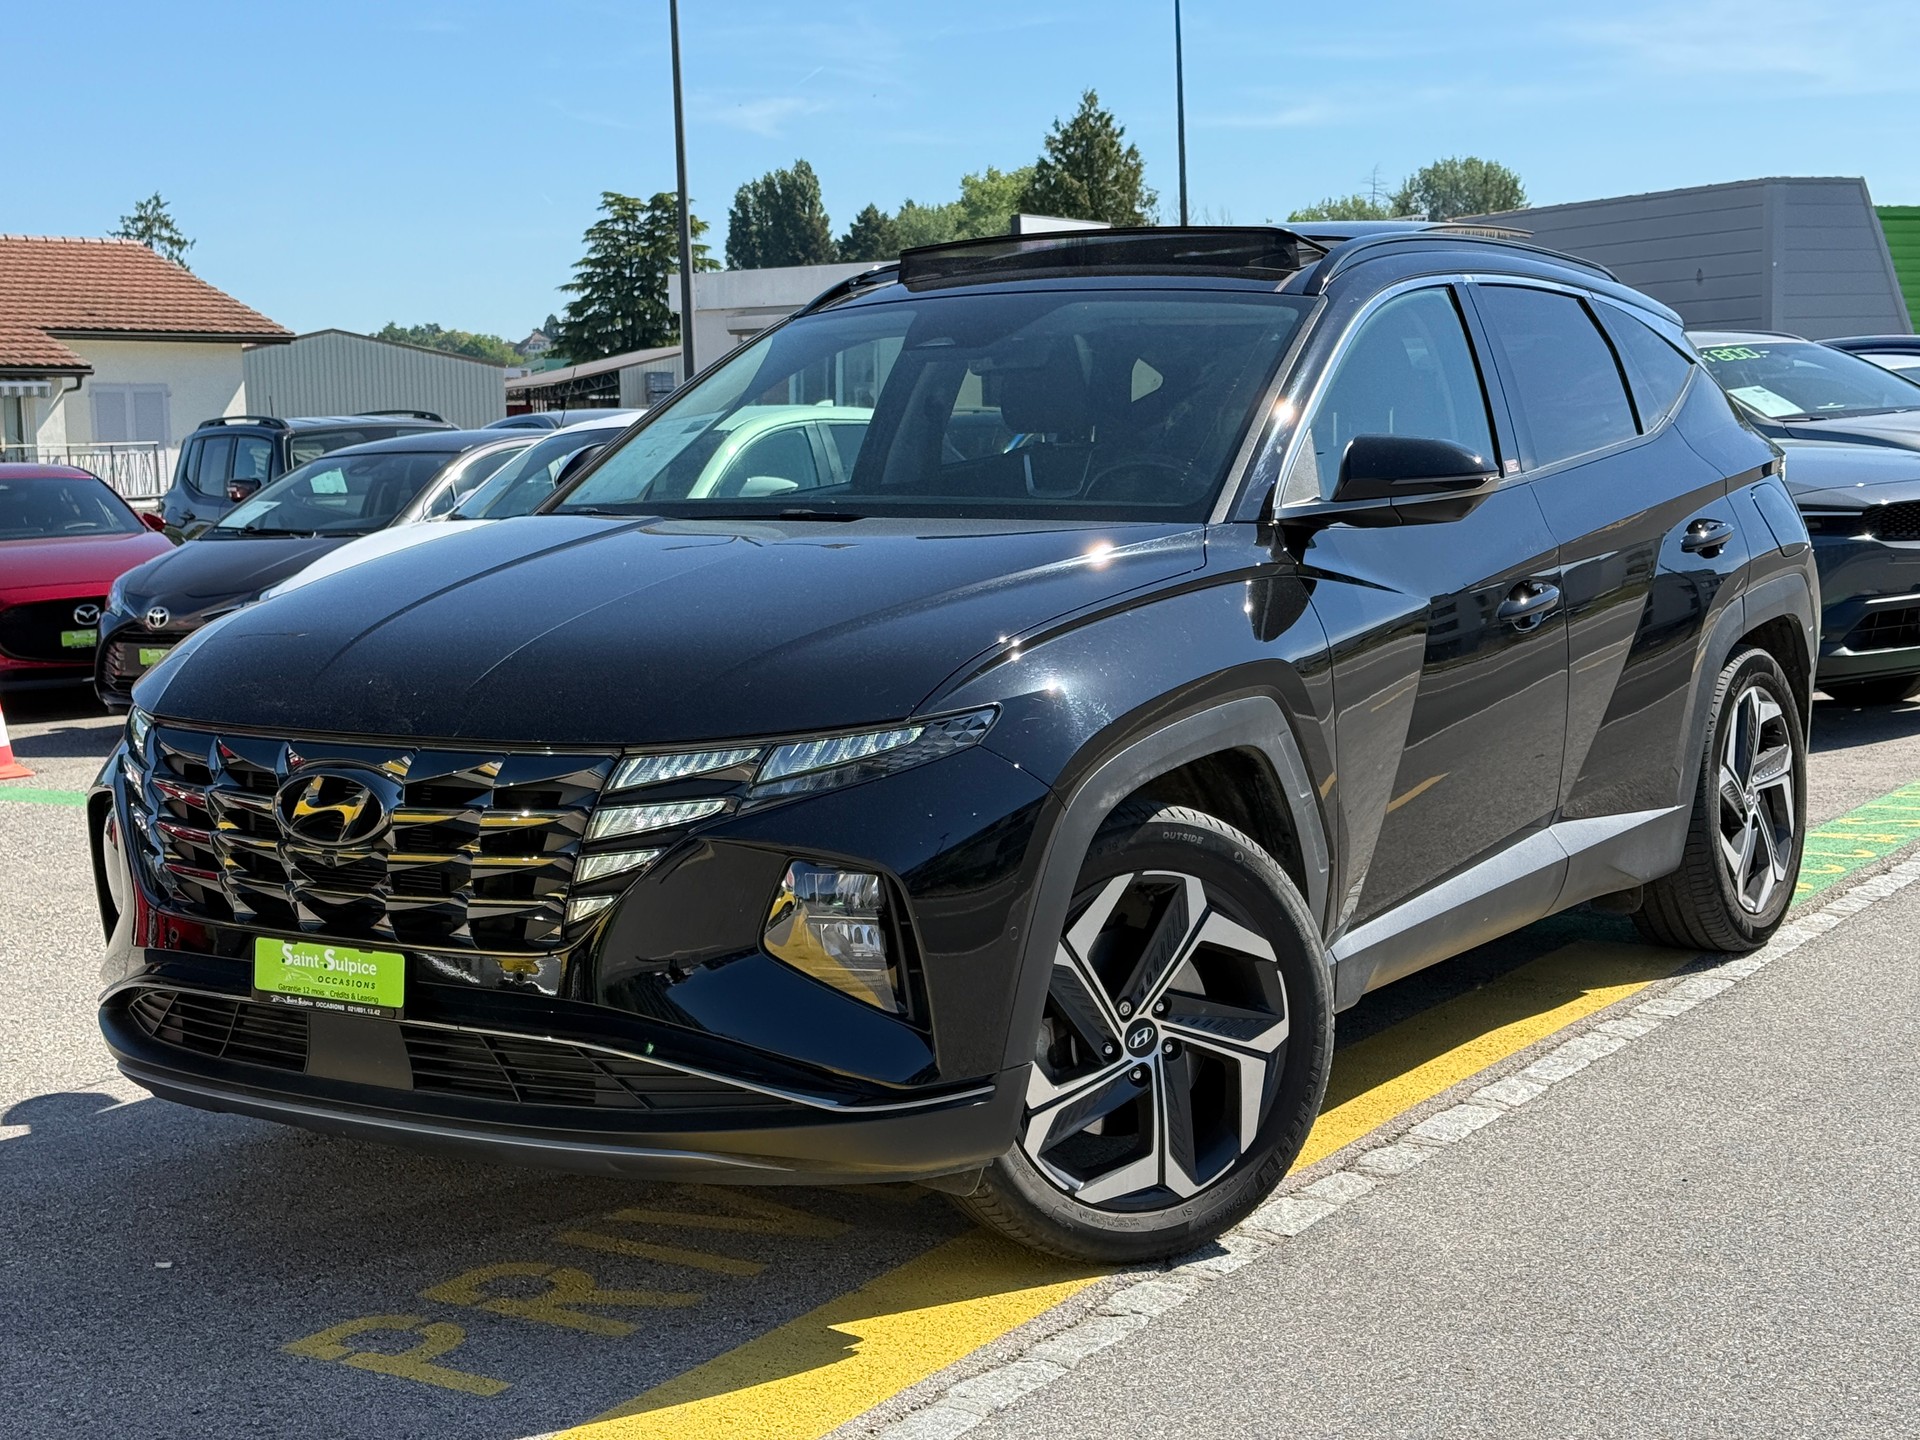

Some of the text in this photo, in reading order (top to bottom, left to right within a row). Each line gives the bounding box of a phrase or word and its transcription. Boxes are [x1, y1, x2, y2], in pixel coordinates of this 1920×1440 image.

[1162, 831, 1205, 845] OUTSIDE
[281, 944, 377, 975] Saint-Sulpice
[317, 975, 376, 990] OCCASIONS
[302, 986, 310, 994] 12
[311, 988, 325, 996] mois
[357, 993, 379, 1004] Leasing
[316, 1001, 345, 1010] OCCASIONS
[1255, 1045, 1325, 1193] MICHELIN
